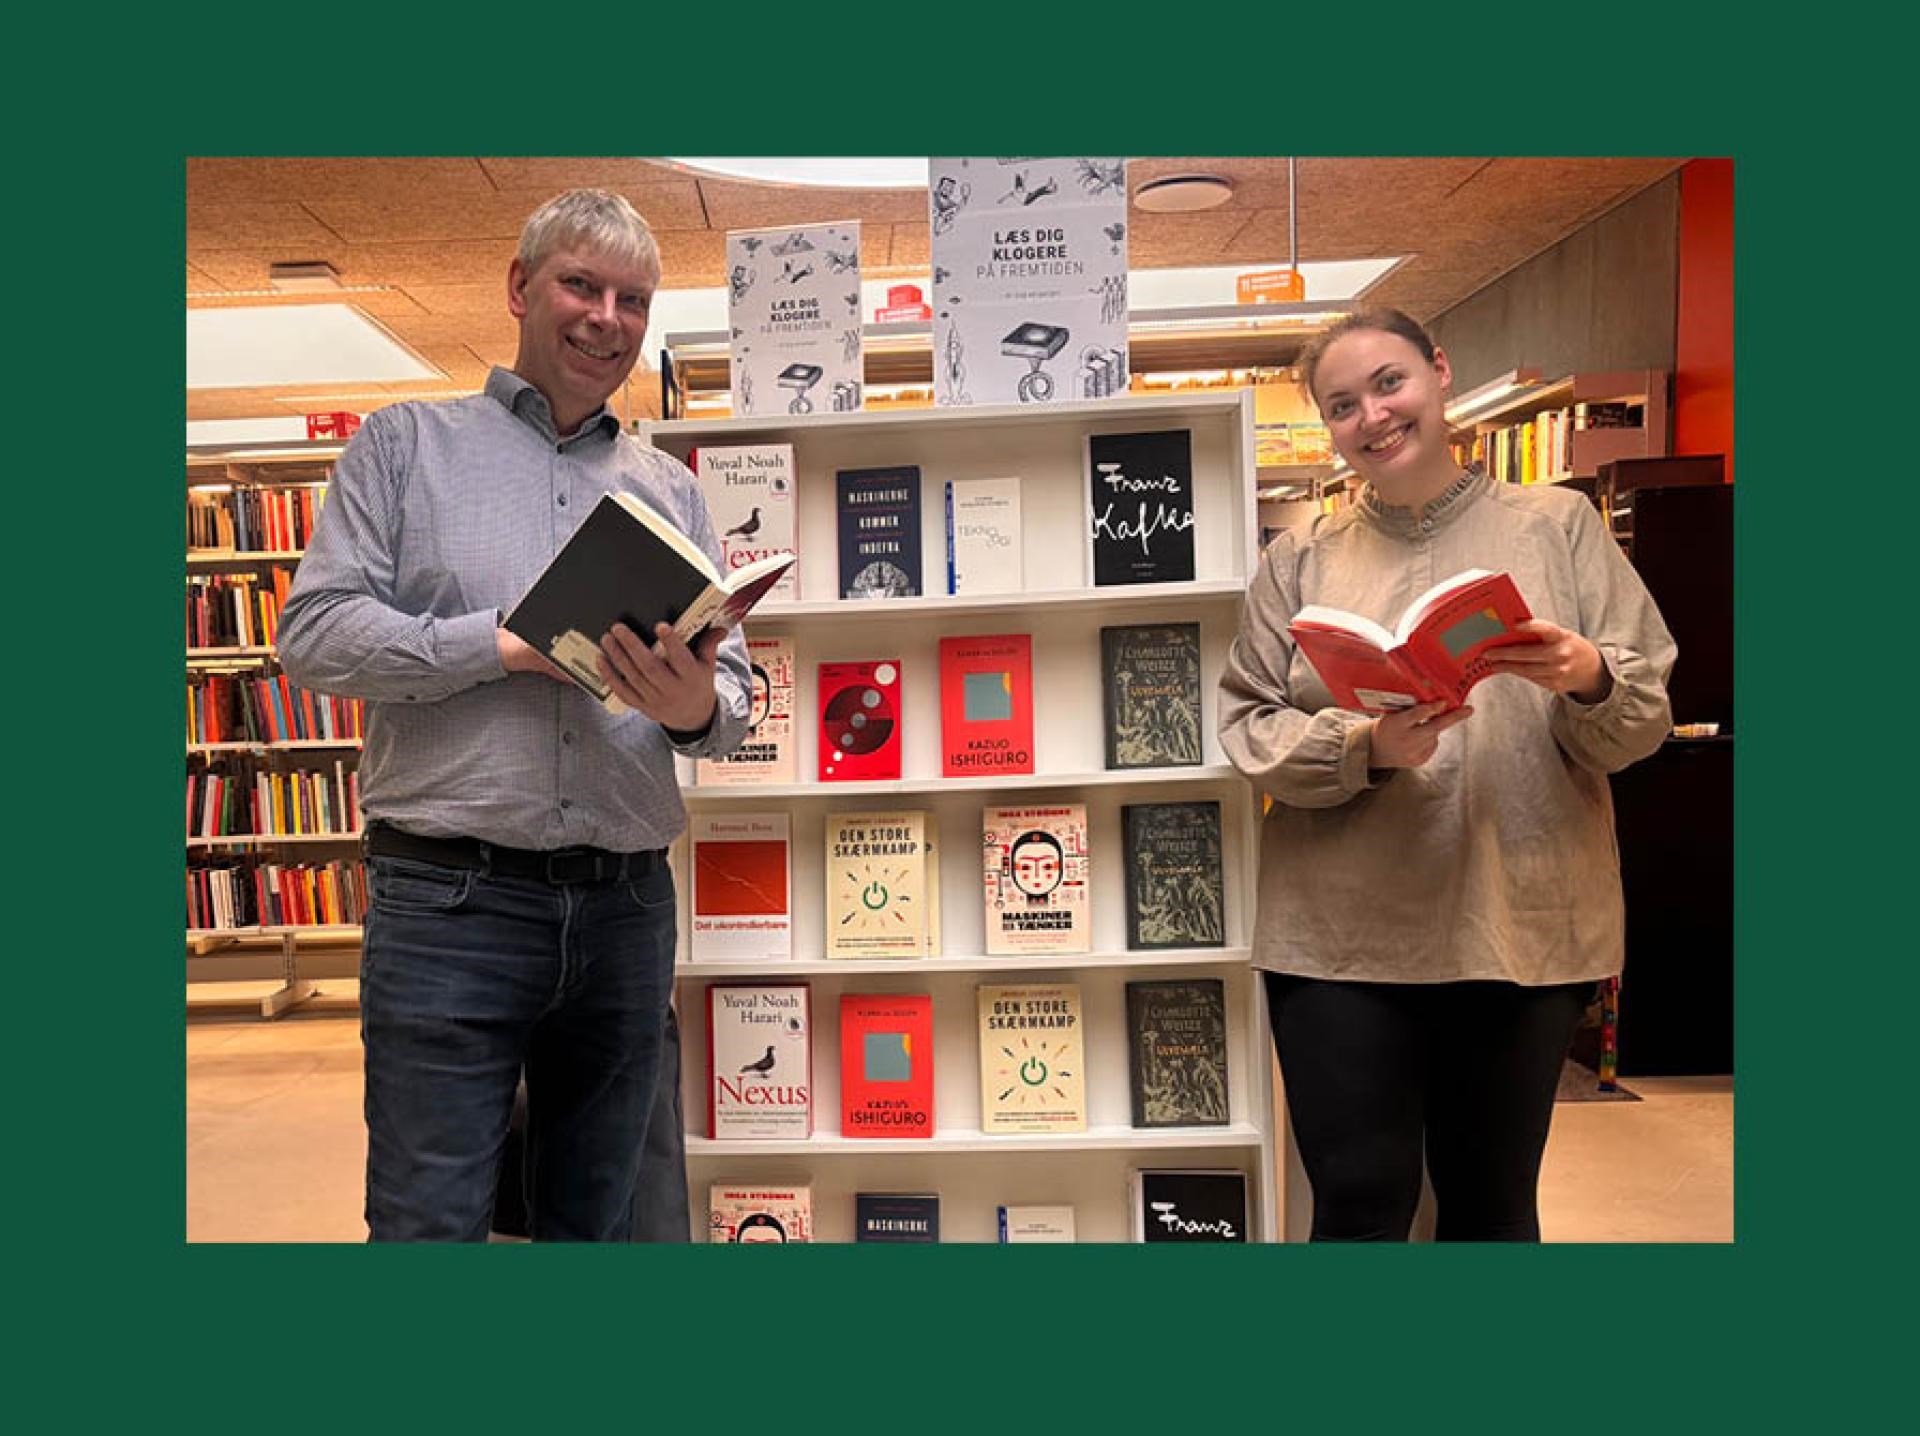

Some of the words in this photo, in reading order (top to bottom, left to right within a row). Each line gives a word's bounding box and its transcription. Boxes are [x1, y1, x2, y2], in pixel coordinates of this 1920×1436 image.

[994, 229, 1030, 245] LÆS
[1036, 228, 1064, 243] DIG
[993, 244, 1068, 261] KLOGERE
[976, 262, 995, 279] PÅ
[1000, 260, 1083, 278] FREMTIDEN
[771, 300, 795, 312] LÆS
[799, 298, 819, 309] DIG
[770, 311, 820, 322] KLOGERE
[707, 456, 742, 470] Yuval
[748, 454, 785, 469] Noah
[725, 472, 768, 485] Harari
[1097, 463, 1181, 493] Franz
[848, 488, 908, 504] MASKINERNE
[1089, 502, 1195, 556] Kafka
[858, 541, 899, 554] INDEFRA
[967, 738, 1010, 750] KAZUO
[950, 751, 1029, 768] ISHIGURO
[839, 829, 864, 843] DEN
[870, 827, 911, 841] STORE
[834, 841, 917, 858] SKÆRMKAMP
[1002, 910, 1072, 920] MASKINER
[1018, 921, 1072, 930] TÆNKER
[724, 994, 757, 1008] Yuval
[763, 993, 799, 1008] Noah
[994, 1001, 1021, 1015] DEN
[1026, 1000, 1069, 1015] STORE
[740, 1011, 783, 1024] Harari
[988, 1014, 1077, 1030] SKÆRMKAMP
[717, 1075, 808, 1105] Nexus
[850, 1111, 927, 1126] ISHIGURO
[868, 1219, 928, 1231] MASKINERNE
[1151, 1202, 1236, 1238] Franz
